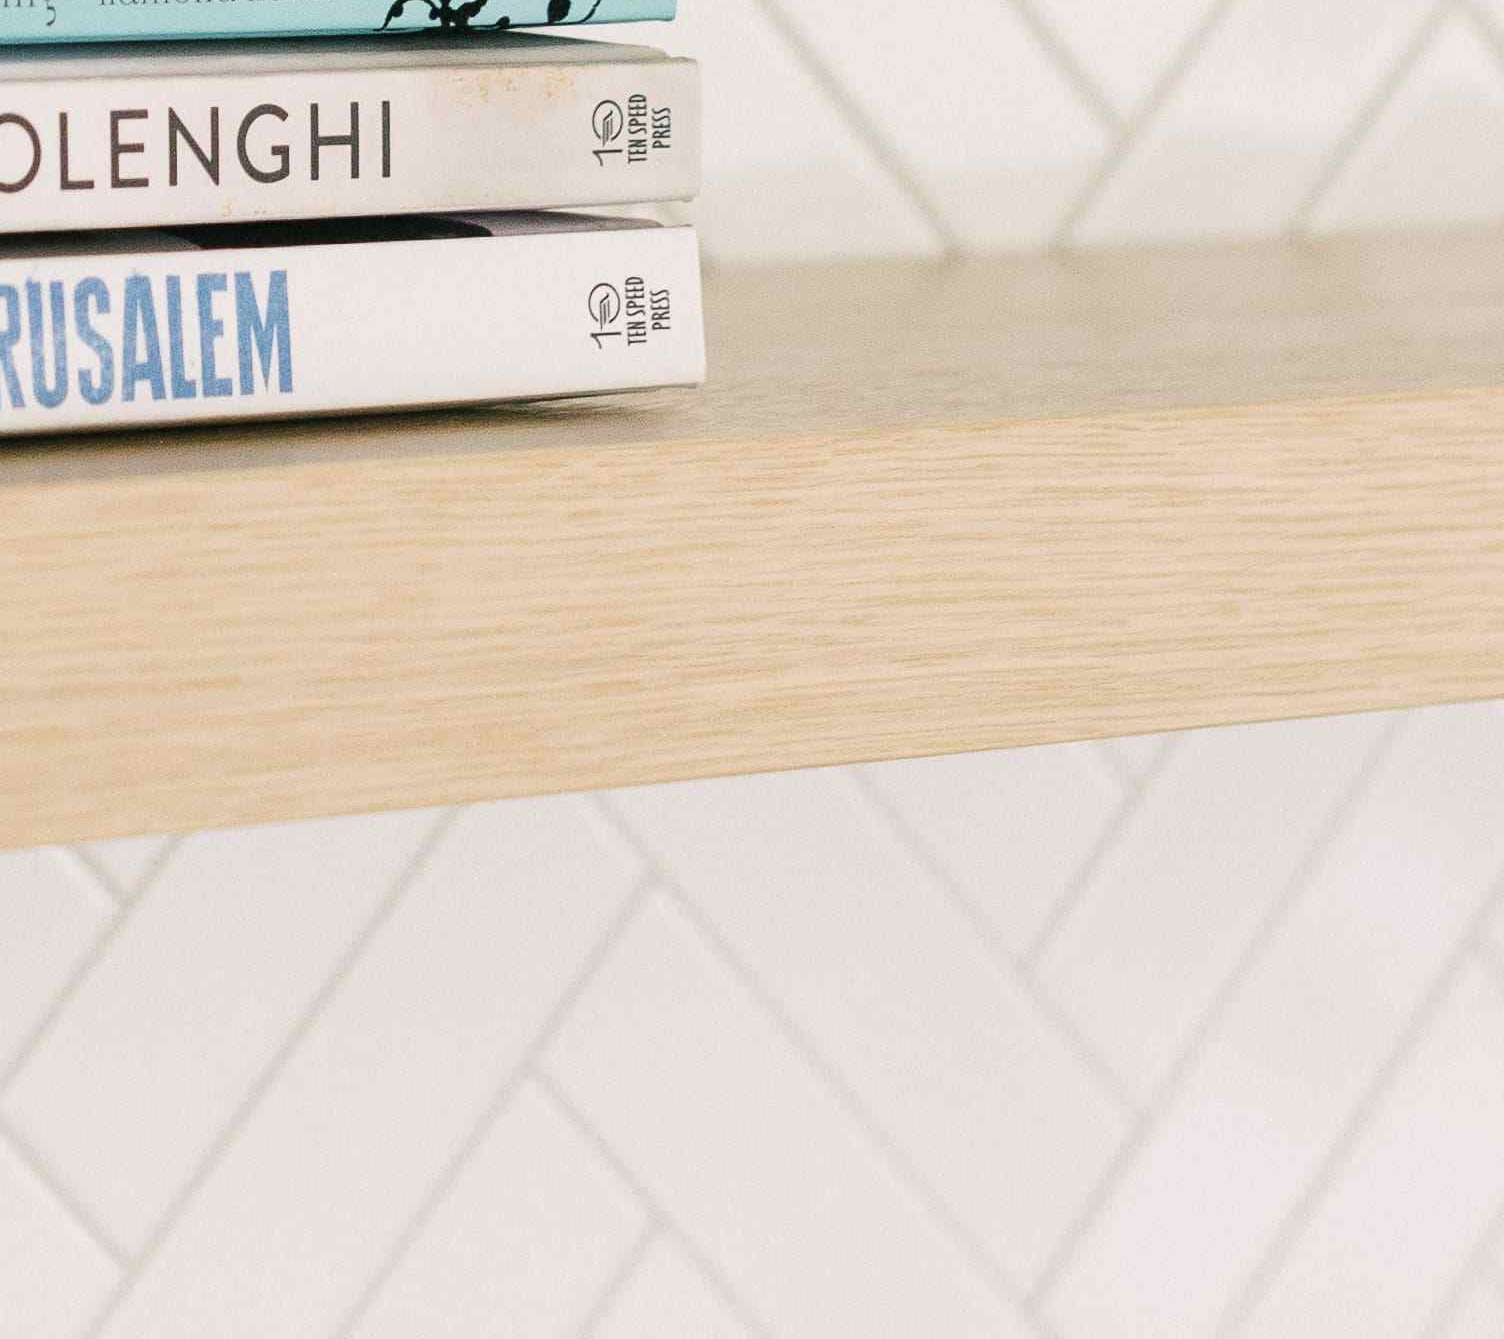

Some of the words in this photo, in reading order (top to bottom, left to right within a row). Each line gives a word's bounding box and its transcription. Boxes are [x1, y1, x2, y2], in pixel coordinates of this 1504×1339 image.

[626, 93, 648, 135] SPEED
[651, 107, 672, 149] PRESS
[626, 138, 648, 164] TEN
[624, 276, 647, 317] SPEED
[649, 289, 672, 331] PRESS
[625, 321, 648, 347] TEN
